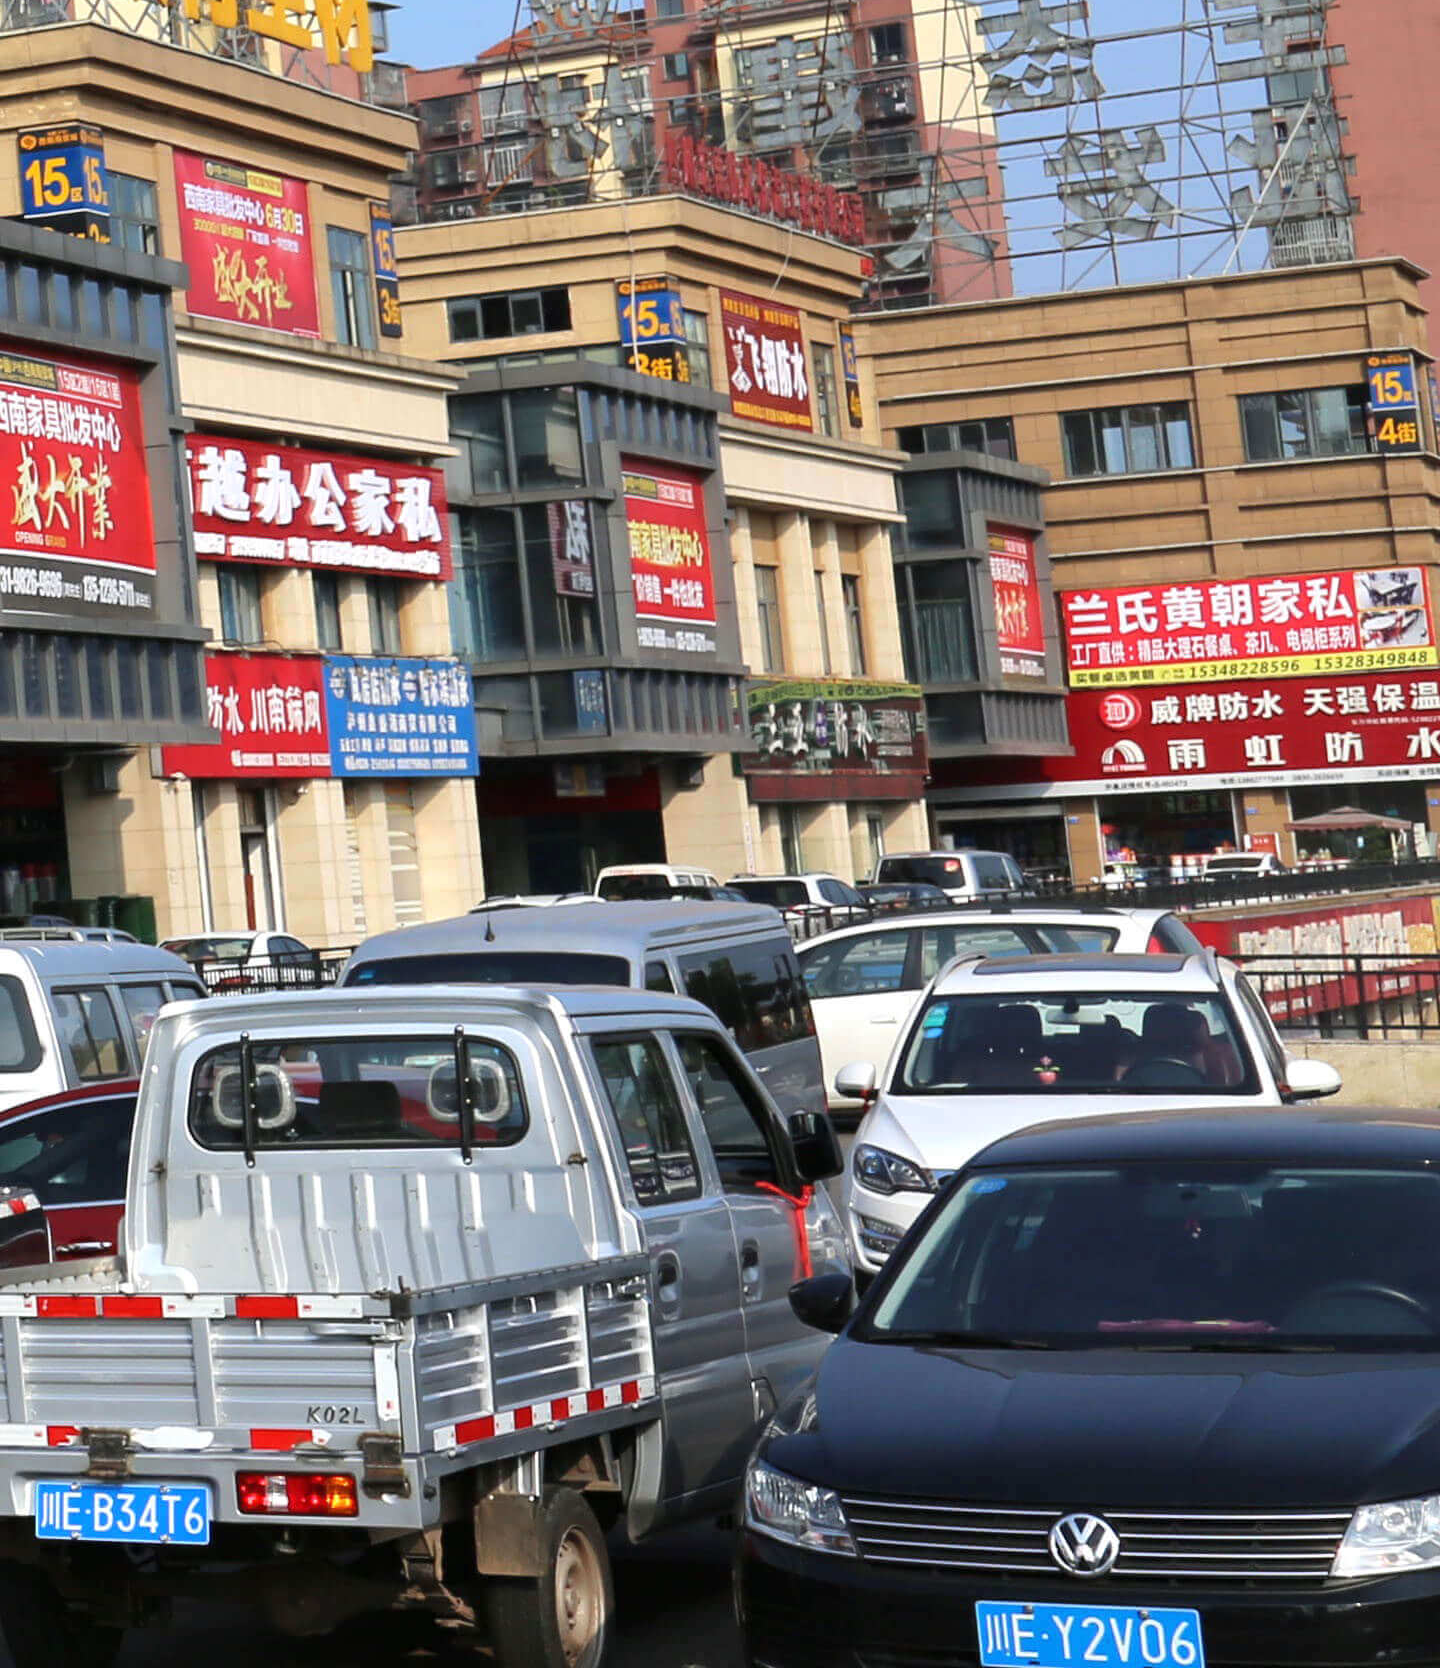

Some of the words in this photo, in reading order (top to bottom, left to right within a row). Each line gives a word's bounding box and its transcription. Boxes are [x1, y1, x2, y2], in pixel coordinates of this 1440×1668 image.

[25, 157, 83, 207] 15区
[1378, 418, 1417, 444] 4街
[186, 446, 442, 543] 越办公家私
[1068, 577, 1353, 637] 兰氏黄朝家私
[1190, 659, 1300, 679] 15348228596
[1314, 651, 1429, 671] 15328349848
[1151, 690, 1284, 725] 威牌防水
[1304, 682, 1440, 716] 天强保温
[1167, 727, 1440, 771] 雨虹防水
[306, 1405, 366, 1426] K02L
